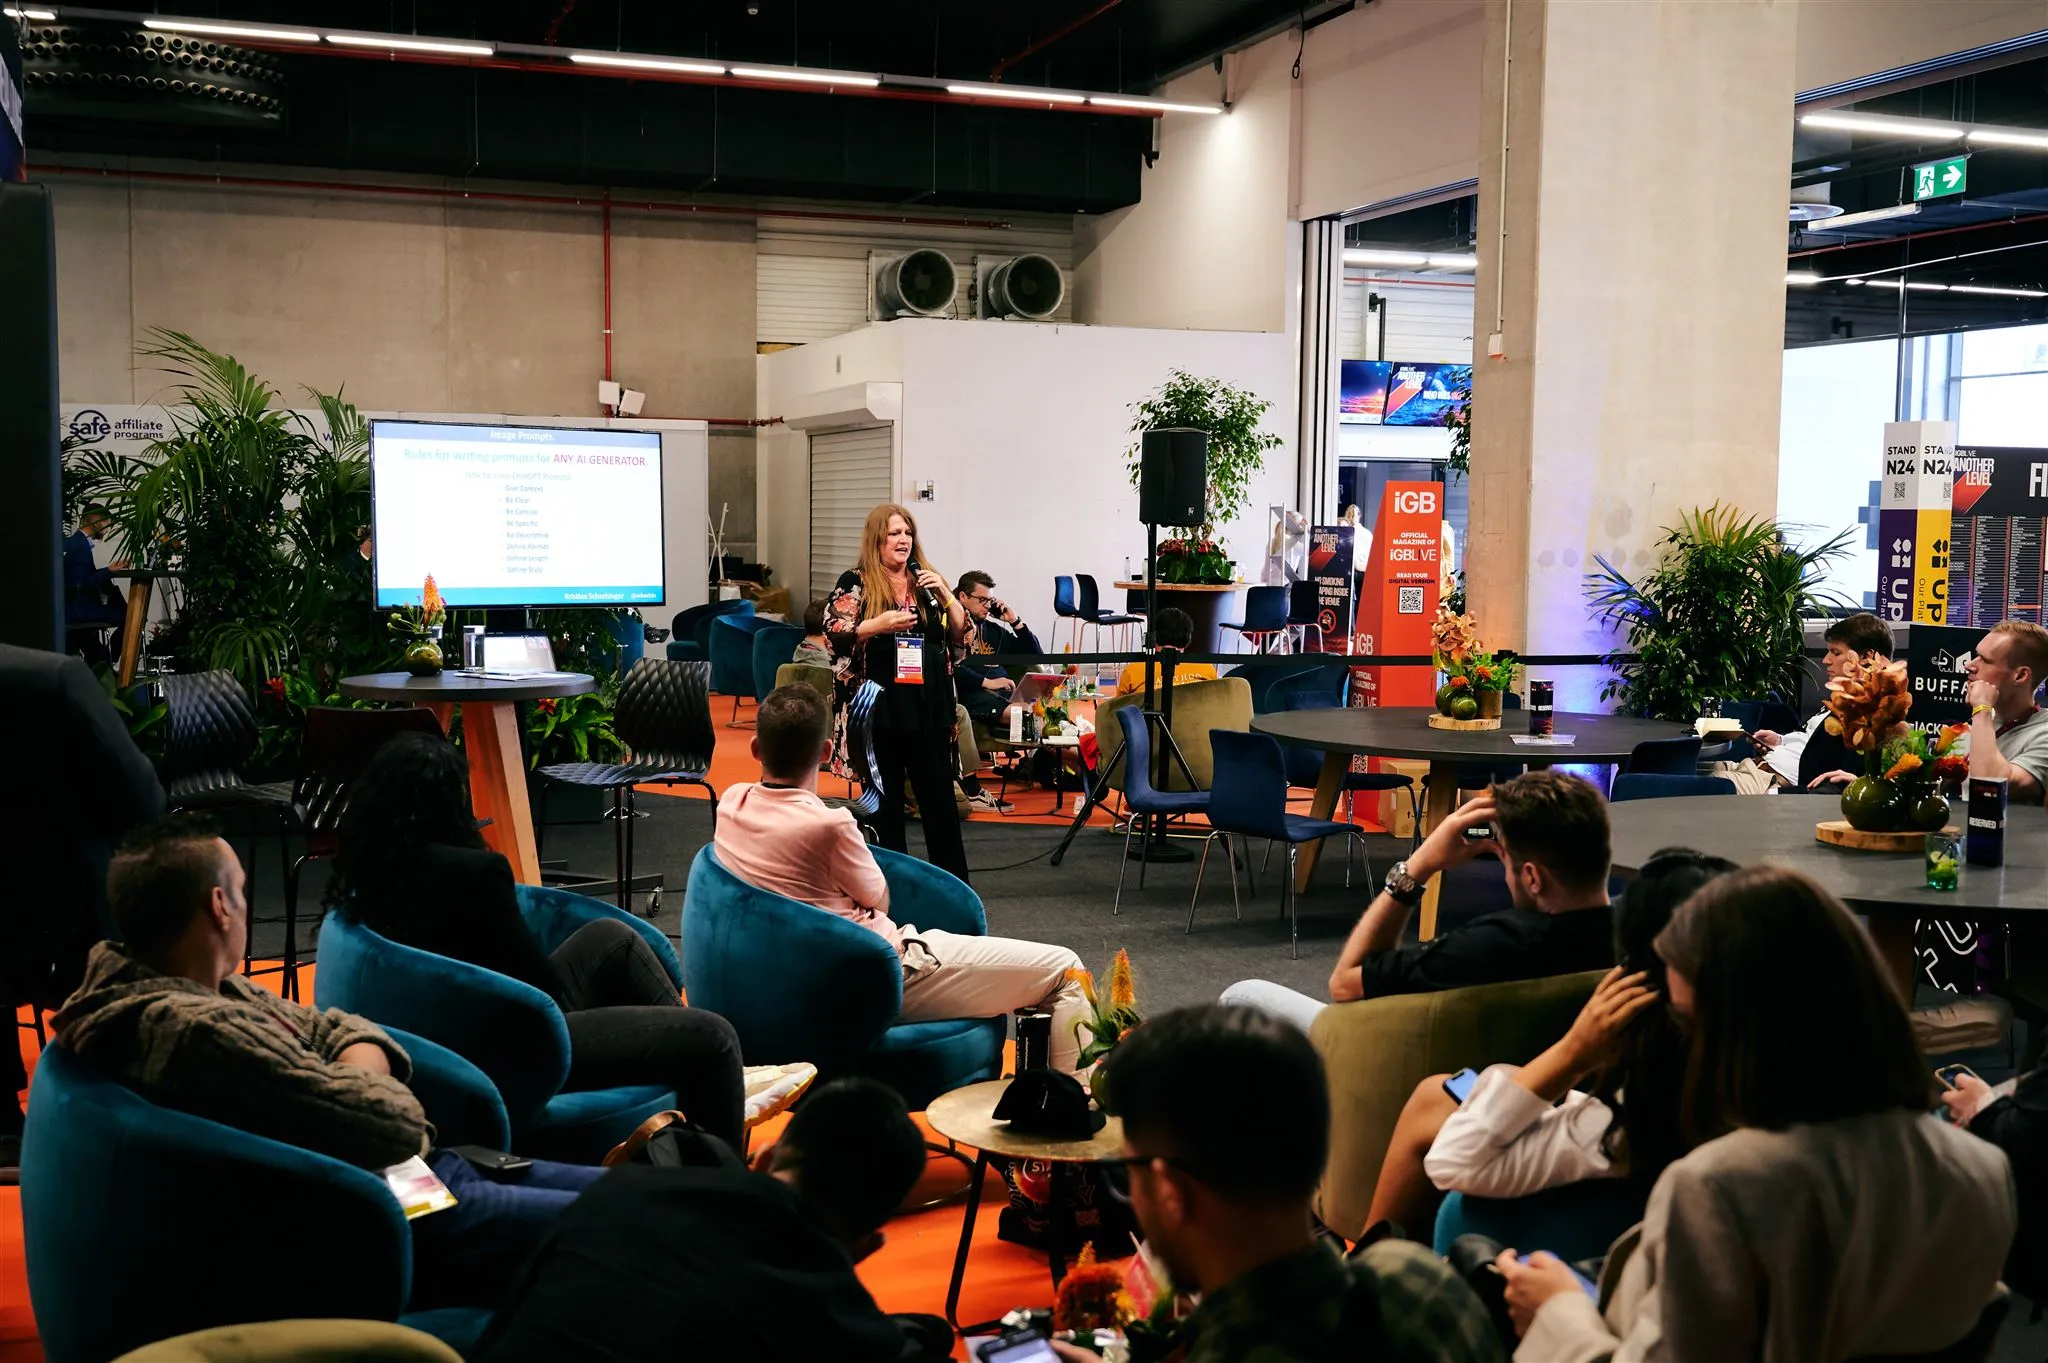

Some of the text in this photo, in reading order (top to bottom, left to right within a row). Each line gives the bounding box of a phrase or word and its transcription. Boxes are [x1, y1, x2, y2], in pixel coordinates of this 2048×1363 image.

[69, 416, 111, 435] safe
[114, 419, 163, 431] affiliate
[114, 431, 164, 439] programs
[490, 430, 516, 442] Image
[404, 449, 433, 460] Rules
[435, 449, 449, 460] for
[453, 450, 489, 463] writing
[492, 452, 534, 464] prompts
[536, 452, 550, 463] for
[553, 454, 573, 464] ANY
[1887, 445, 1917, 456] STAND
[1954, 449, 1977, 458] GBLVE
[1886, 459, 1916, 475] N24
[1923, 459, 1952, 475] N24
[1954, 457, 1995, 473] ANOTHER
[1965, 472, 1992, 486] LEVEL
[2029, 462, 2048, 497] FI
[1394, 491, 1436, 514] iGB
[1313, 533, 1339, 543] ANOTHER
[1321, 543, 1337, 553] LEVEL
[1322, 576, 1345, 587] SMOKING
[1319, 586, 1349, 597] APING INSIDE
[1325, 596, 1341, 606] VENUE
[1356, 632, 1374, 656] iGB
[1355, 670, 1372, 680] OFFICIAL
[1352, 679, 1371, 690] AGAZINE
[1915, 676, 1969, 695] BUFFA
[1933, 695, 1964, 703] PARTNE
